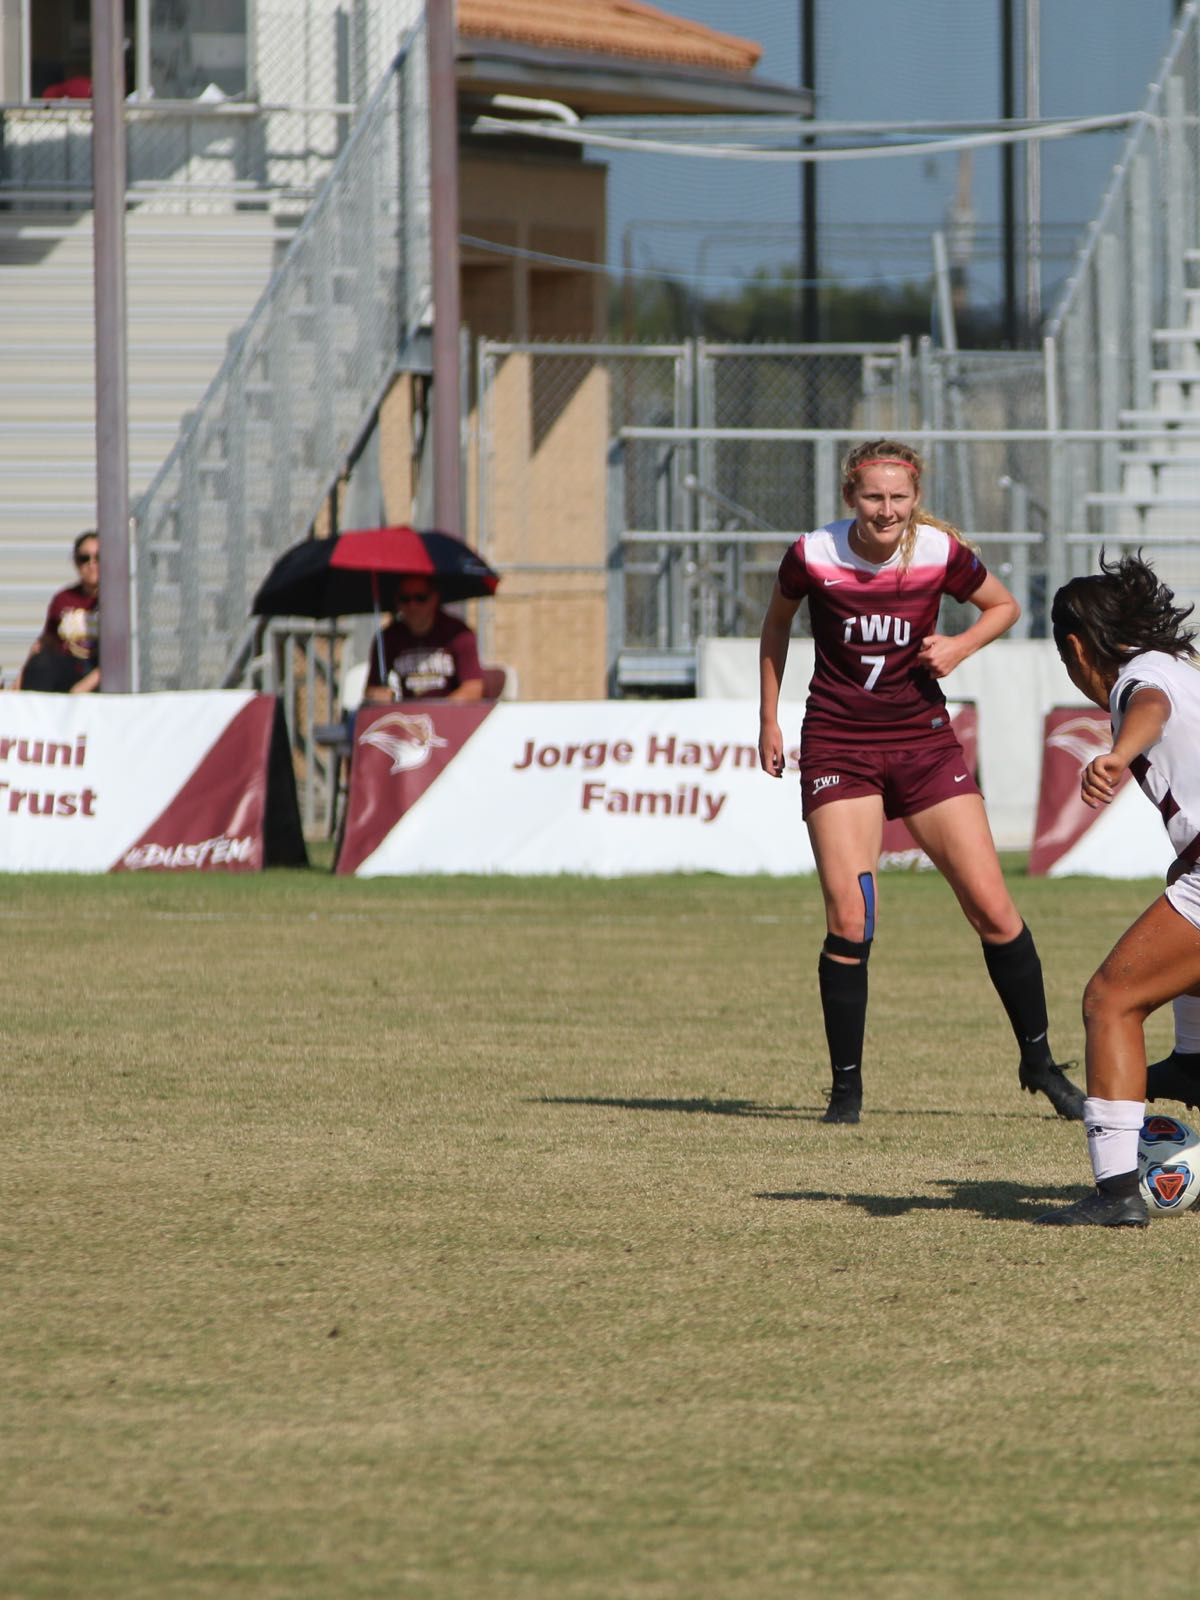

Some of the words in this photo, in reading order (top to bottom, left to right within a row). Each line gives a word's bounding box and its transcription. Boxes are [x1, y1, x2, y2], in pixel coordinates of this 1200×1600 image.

[843, 614, 911, 647] TWU
[861, 655, 886, 692] 7
[513, 740, 635, 771] Jorge
[647, 735, 801, 774] Hayns
[813, 775, 840, 789] TWU
[582, 781, 726, 823] Family
